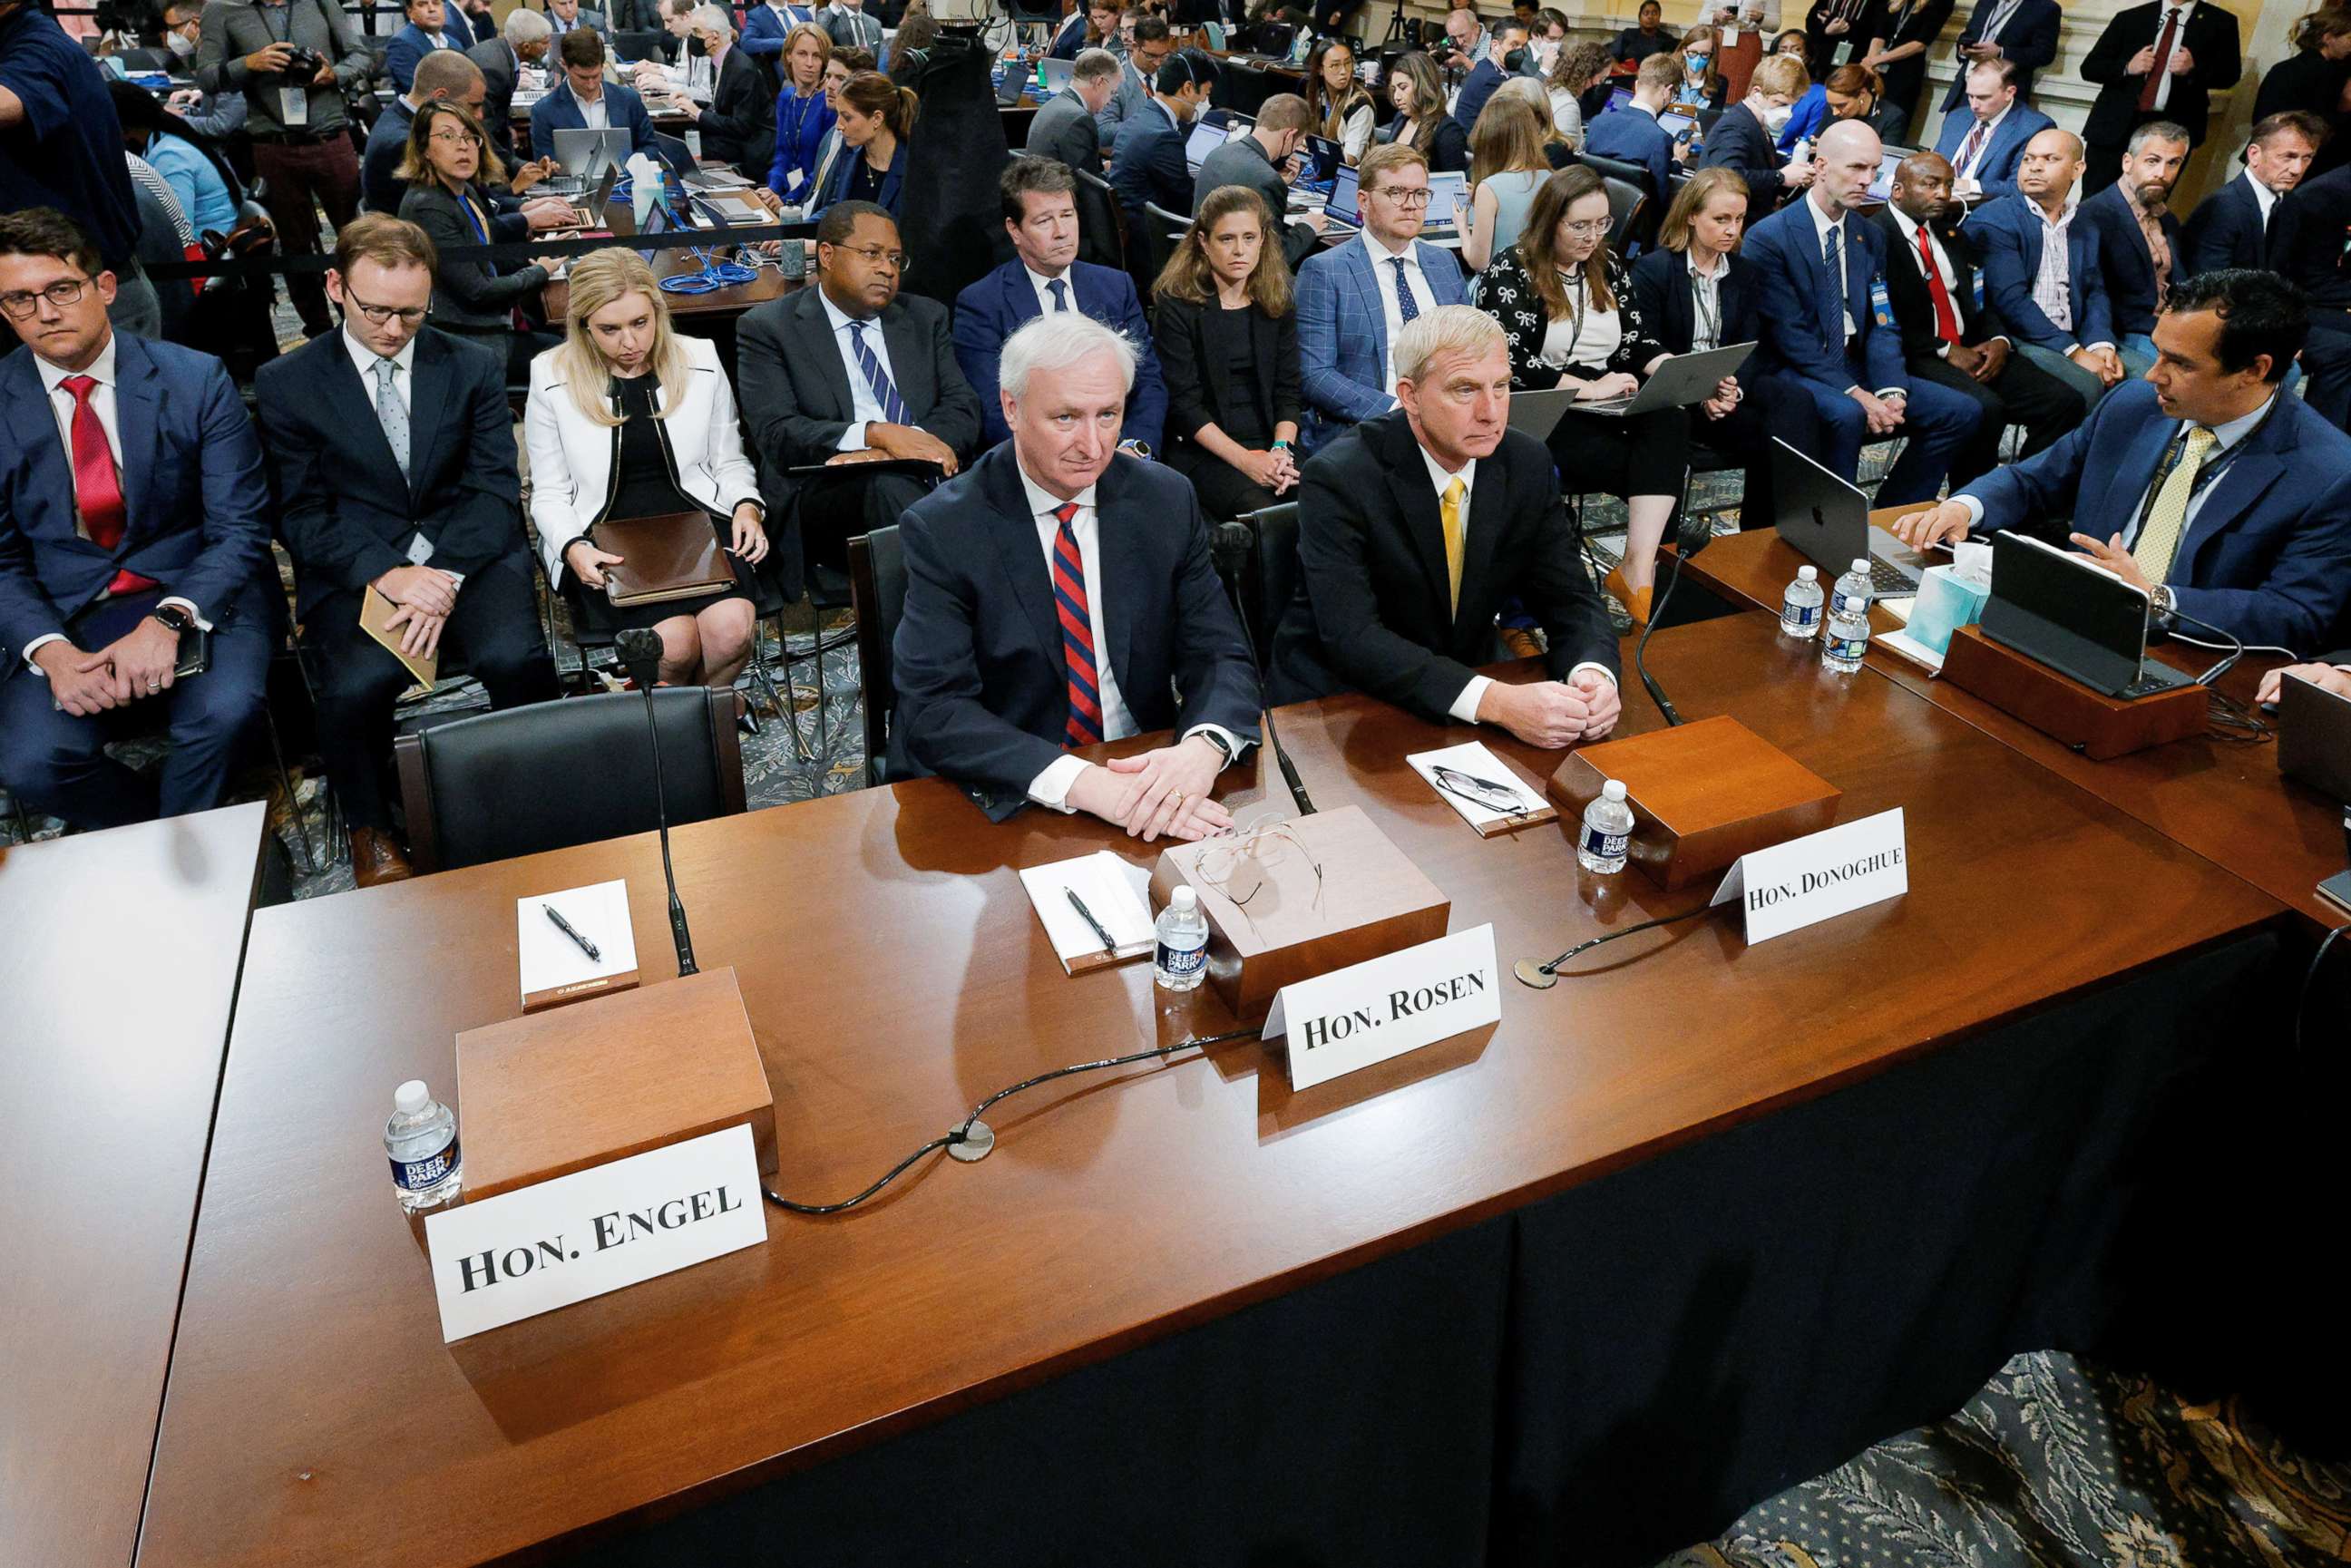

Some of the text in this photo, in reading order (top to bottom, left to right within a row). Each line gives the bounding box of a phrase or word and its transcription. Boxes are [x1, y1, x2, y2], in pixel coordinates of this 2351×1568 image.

[1749, 847, 1903, 911] HON. DONOGHUE
[1167, 959, 1197, 969] PARK
[1168, 950, 1197, 962] DEER
[1302, 969, 1485, 1051] HON. ROSEN
[405, 1155, 444, 1175] DEER
[406, 1165, 448, 1183] PARK
[455, 1185, 743, 1294] HON. ENGEL
